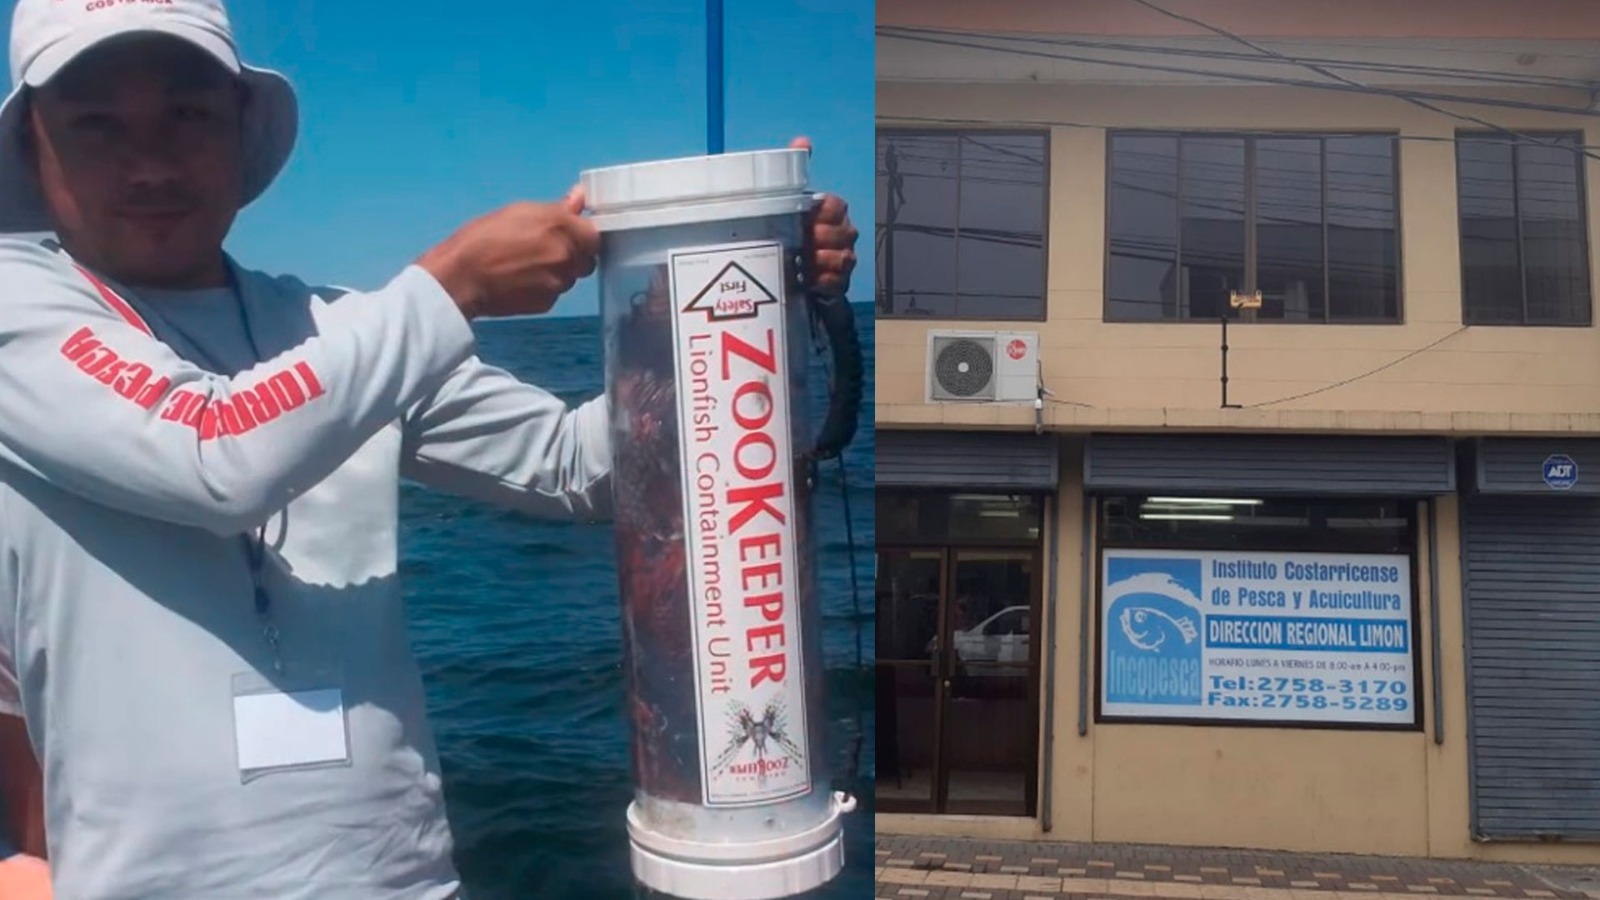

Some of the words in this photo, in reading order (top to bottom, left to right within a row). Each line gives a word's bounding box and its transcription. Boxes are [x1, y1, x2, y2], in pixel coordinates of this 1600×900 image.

[720, 281, 746, 293] First
[716, 299, 753, 314] Safety
[60, 326, 171, 410] PESCA
[689, 334, 719, 442] Lionfish
[1548, 464, 1573, 478] ADT
[721, 328, 787, 689] ZOOKEEPER
[696, 452, 726, 627] Containment
[1212, 559, 1277, 580] Instituto
[1284, 561, 1399, 583] Costarricense
[1211, 587, 1231, 606] de
[1238, 587, 1286, 608] Pesca
[1293, 591, 1302, 609] y
[1309, 590, 1401, 611] Acuicultura
[1209, 619, 1282, 645] DIRECCION
[1287, 622, 1356, 647] REGIONAL
[1360, 624, 1404, 648] LIMON
[708, 637, 733, 694] Unit
[1110, 650, 1200, 699] Incopesca
[1208, 657, 1244, 668] HORARIO
[1246, 658, 1272, 669] LUNES
[1273, 659, 1279, 668] A
[1281, 659, 1314, 670] VIERNES
[1316, 660, 1327, 671] DE
[1363, 661, 1371, 671] A
